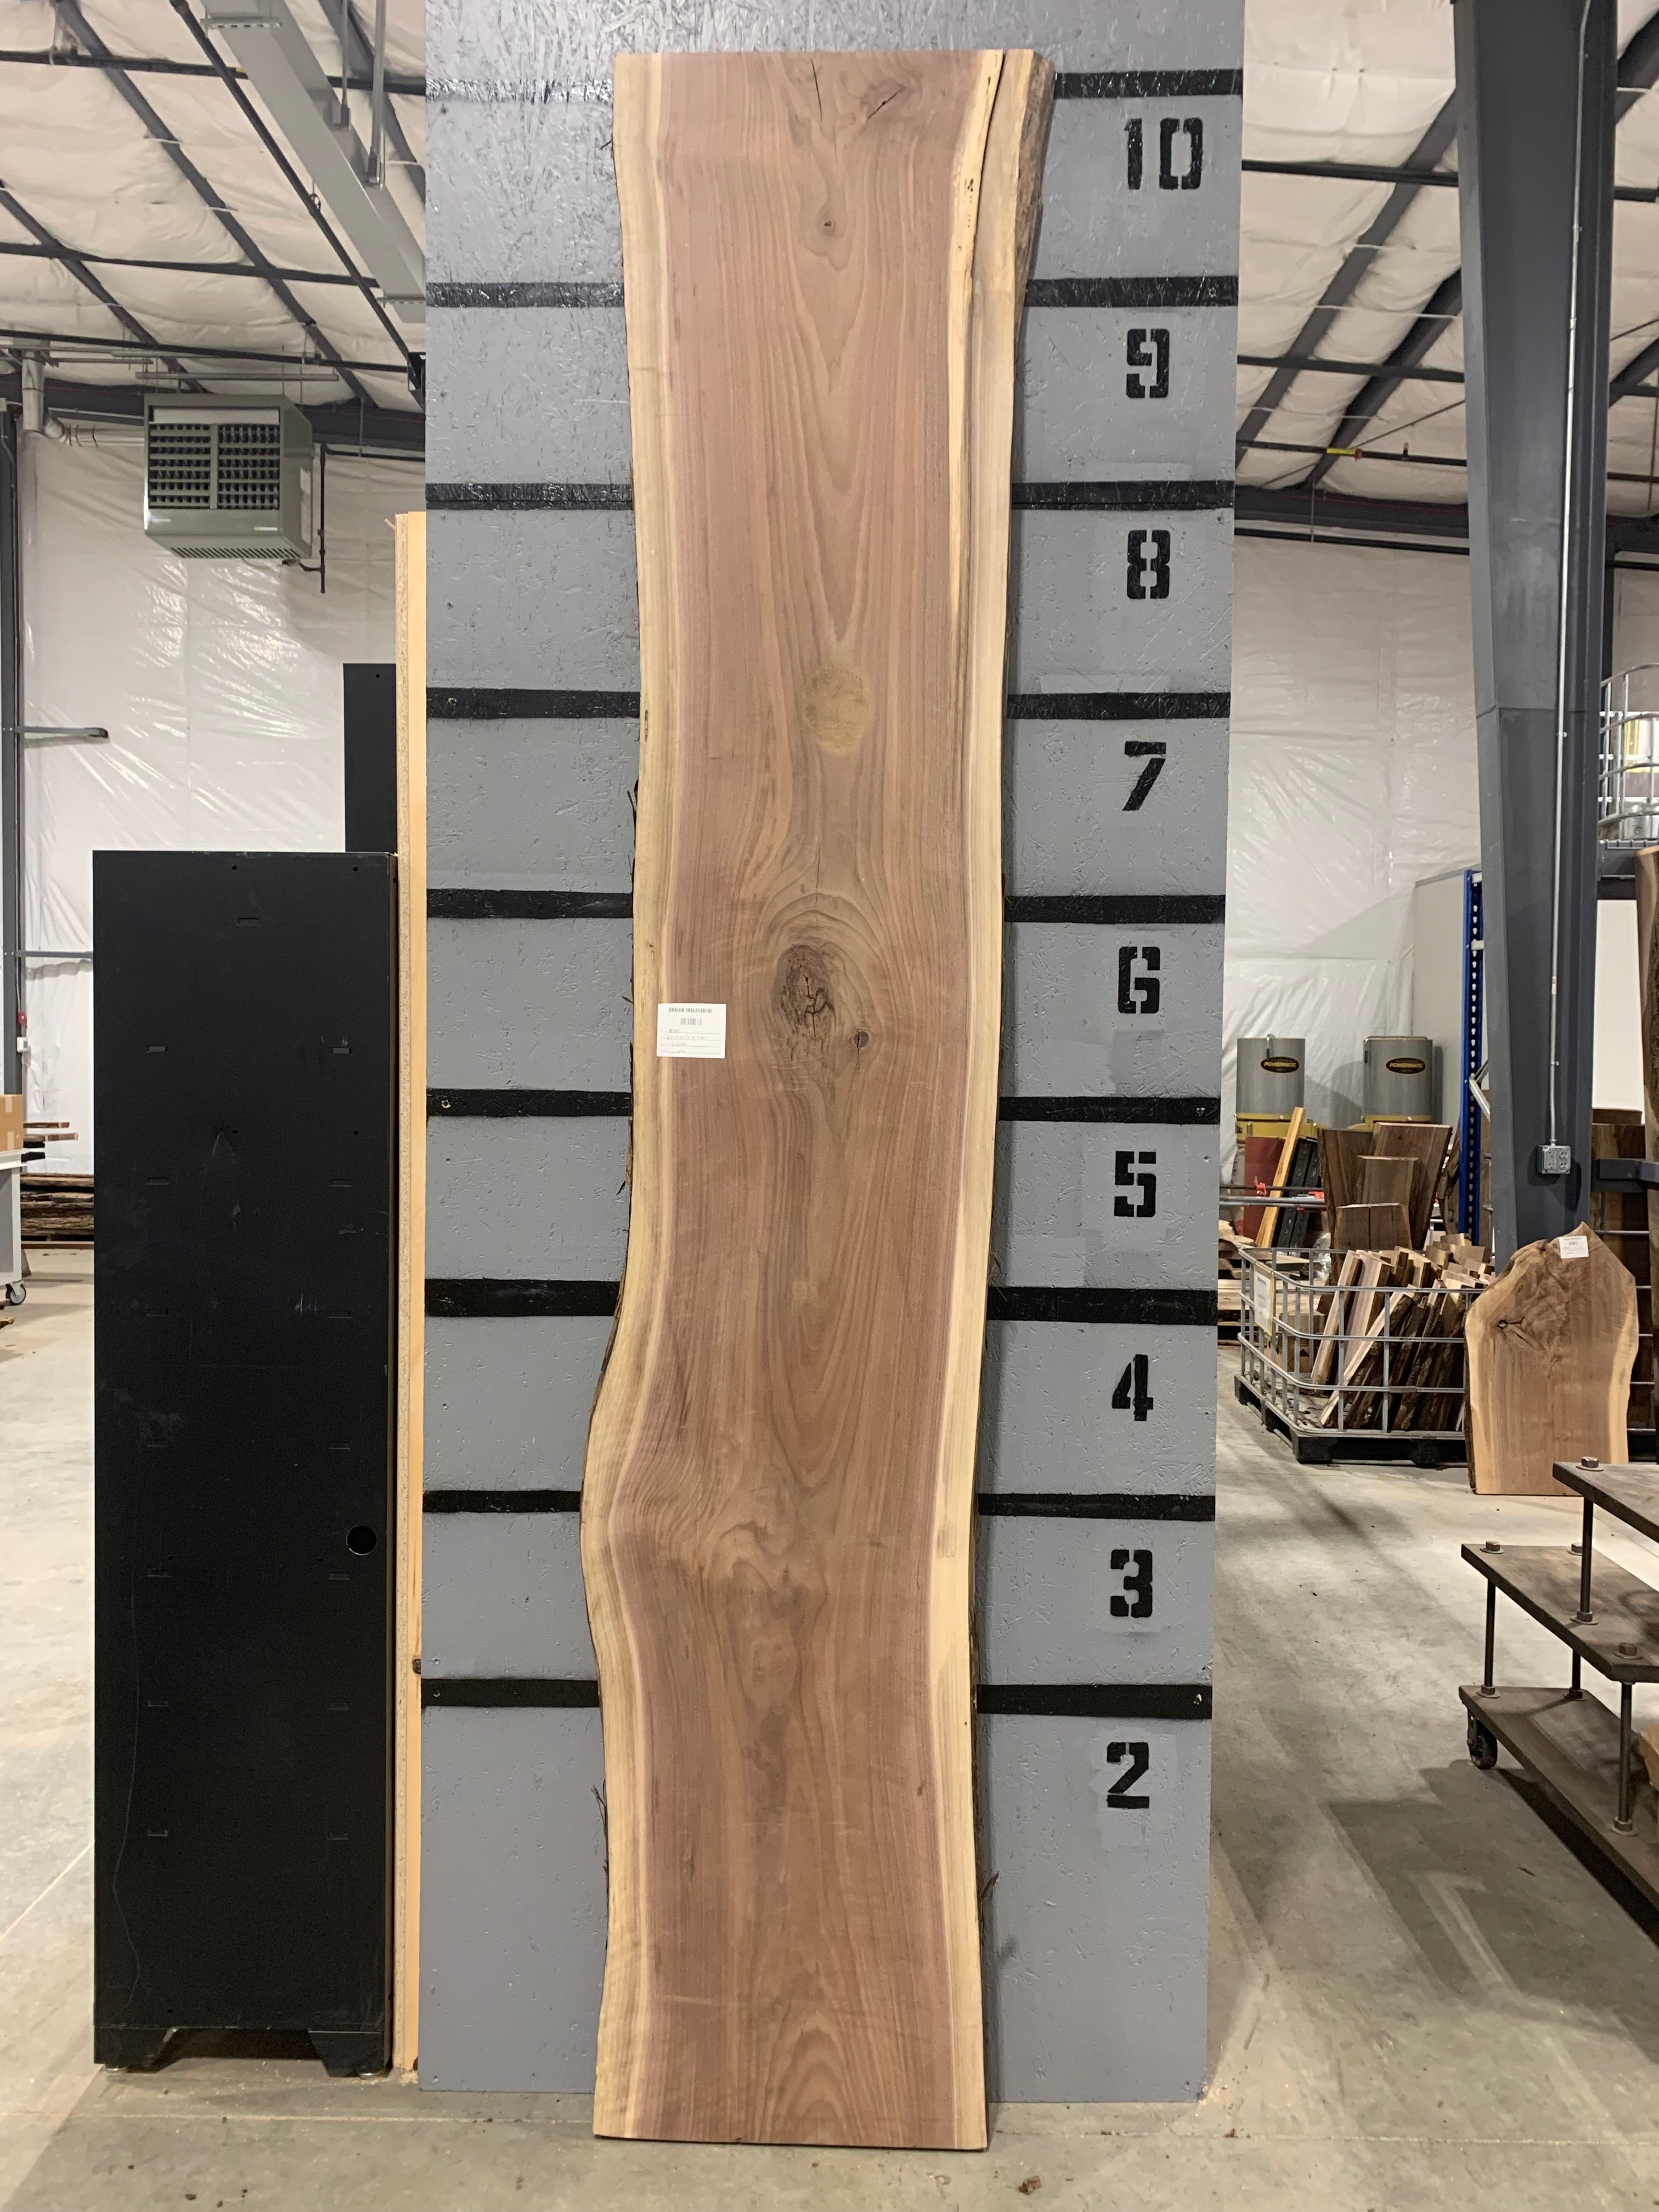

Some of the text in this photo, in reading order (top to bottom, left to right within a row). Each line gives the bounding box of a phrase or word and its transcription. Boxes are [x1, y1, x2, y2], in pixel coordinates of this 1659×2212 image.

[1126, 117, 1203, 189] 10
[1126, 329, 1169, 398] 9
[1127, 530, 1170, 599] 8
[1122, 741, 1166, 810] 7
[1118, 946, 1160, 1013] 6
[1114, 1151, 1156, 1217] 5
[1112, 1354, 1153, 1421] 4
[1110, 1549, 1152, 1618] 3
[1107, 1742, 1149, 1809] 2
